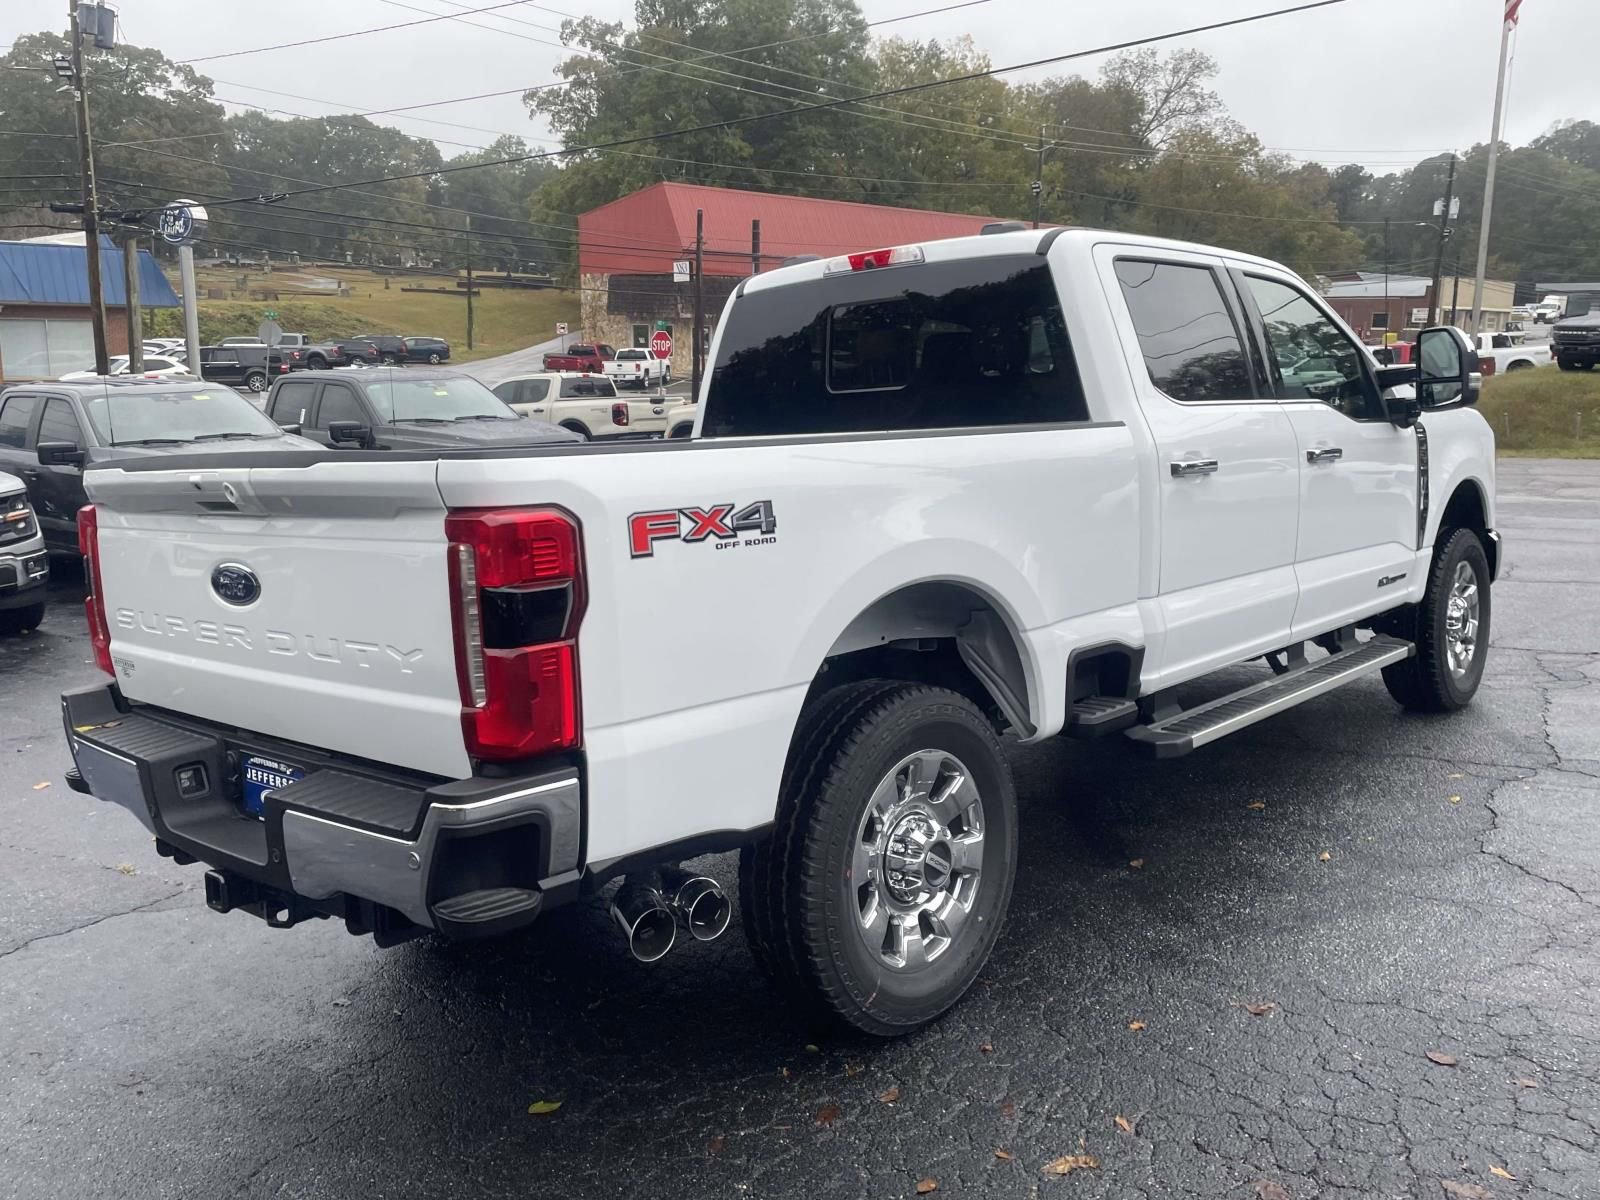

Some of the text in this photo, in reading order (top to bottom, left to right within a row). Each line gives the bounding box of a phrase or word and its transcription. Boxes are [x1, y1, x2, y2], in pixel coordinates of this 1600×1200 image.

[652, 340, 671, 352] STOP
[627, 500, 776, 560] FX4
[715, 536, 777, 550] OFF ROAD
[116, 607, 424, 674] SUPER DUTY
